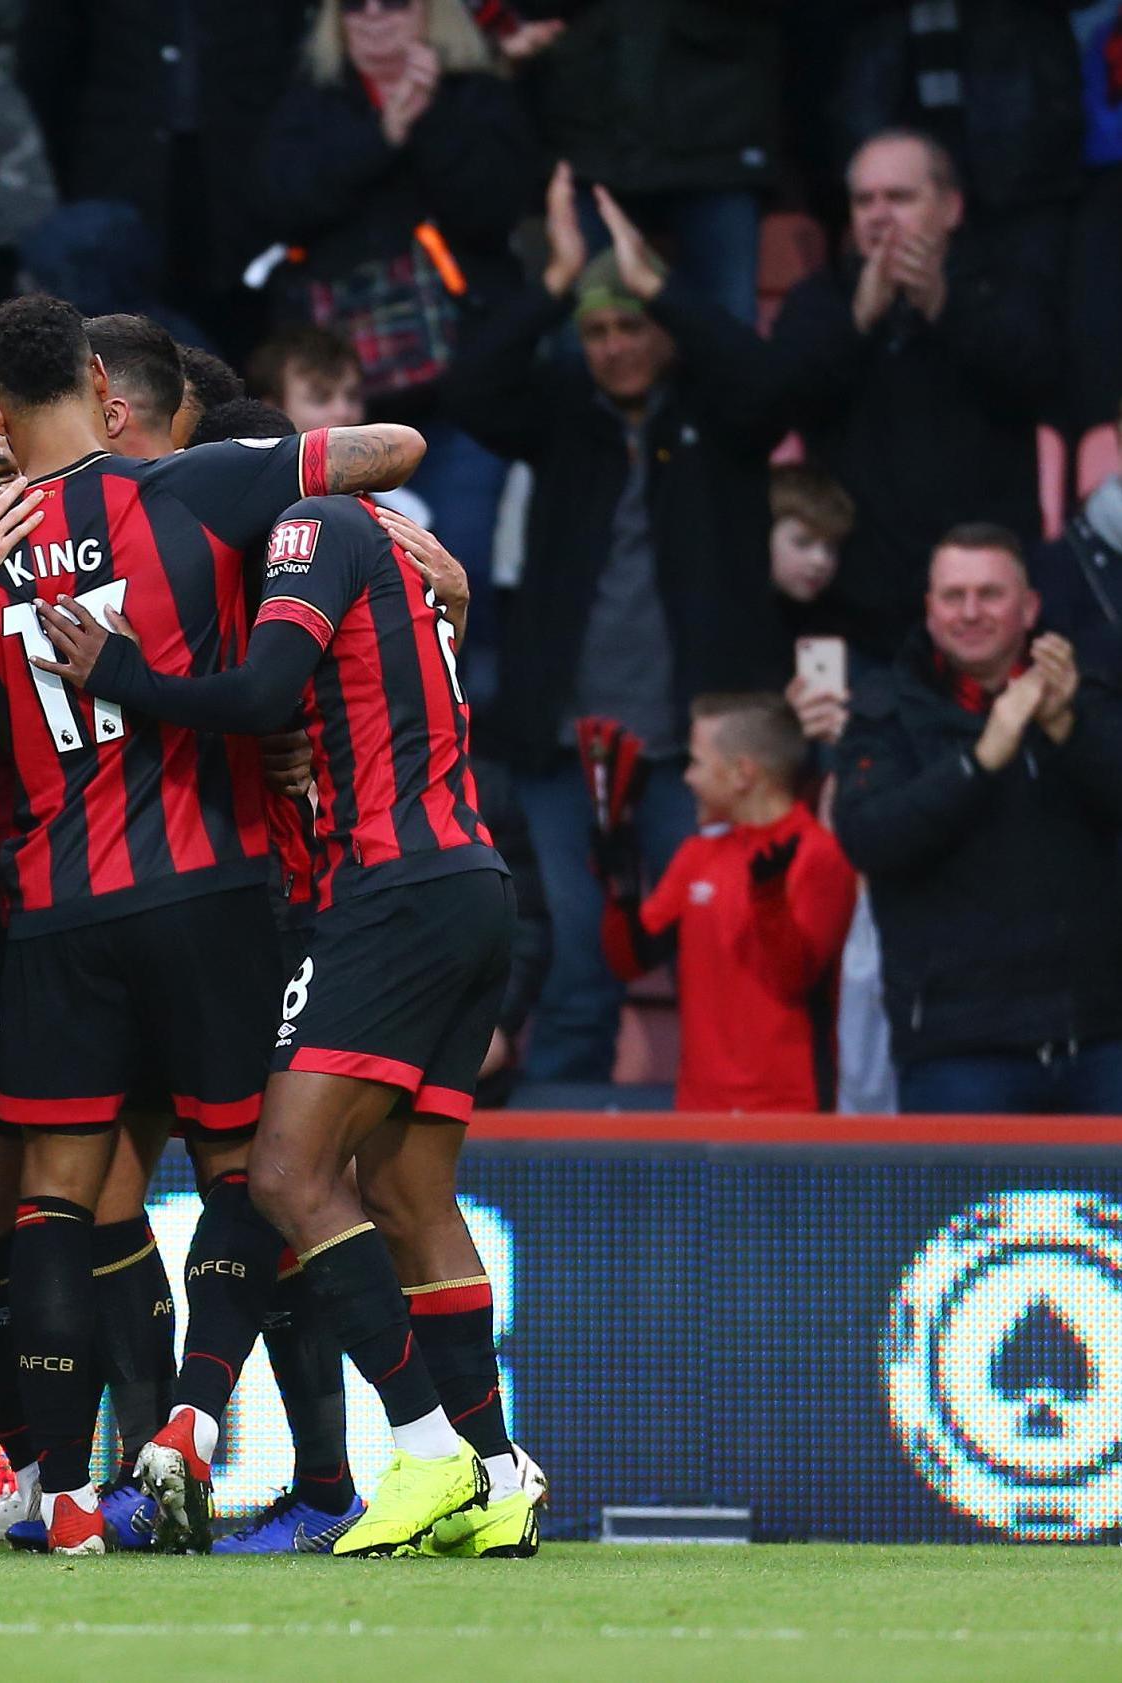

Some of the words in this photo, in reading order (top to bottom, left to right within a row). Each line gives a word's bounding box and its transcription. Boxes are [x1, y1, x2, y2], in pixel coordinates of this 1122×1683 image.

[3, 538, 103, 588] KING
[2, 578, 127, 752] 17
[282, 956, 314, 1021] 8
[188, 1260, 246, 1281] AFCB
[19, 1354, 74, 1372] AFCB
